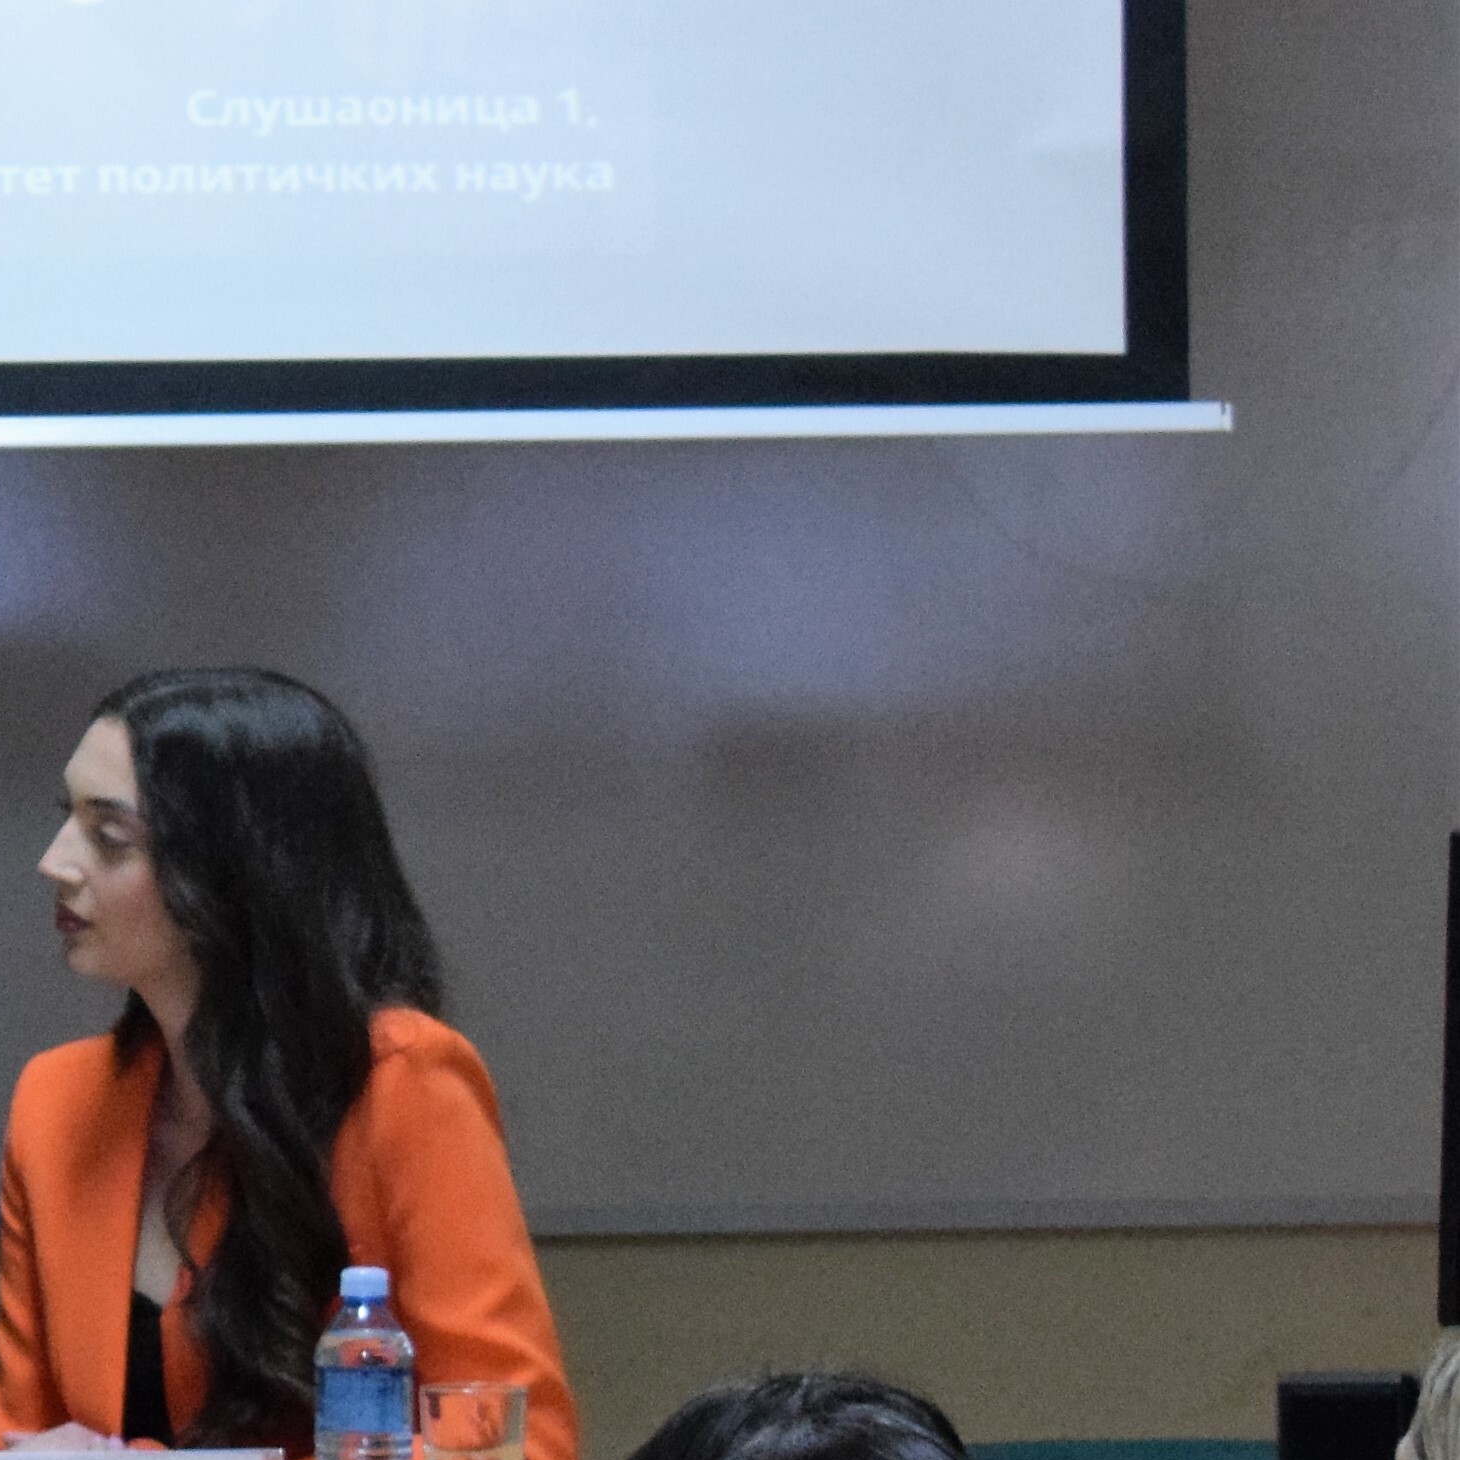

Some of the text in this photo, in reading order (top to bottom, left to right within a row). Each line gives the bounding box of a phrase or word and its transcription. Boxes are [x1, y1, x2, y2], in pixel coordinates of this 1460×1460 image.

[185, 89, 542, 138] Слушаоница
[97, 160, 440, 195] политичких
[454, 158, 615, 203] наука
